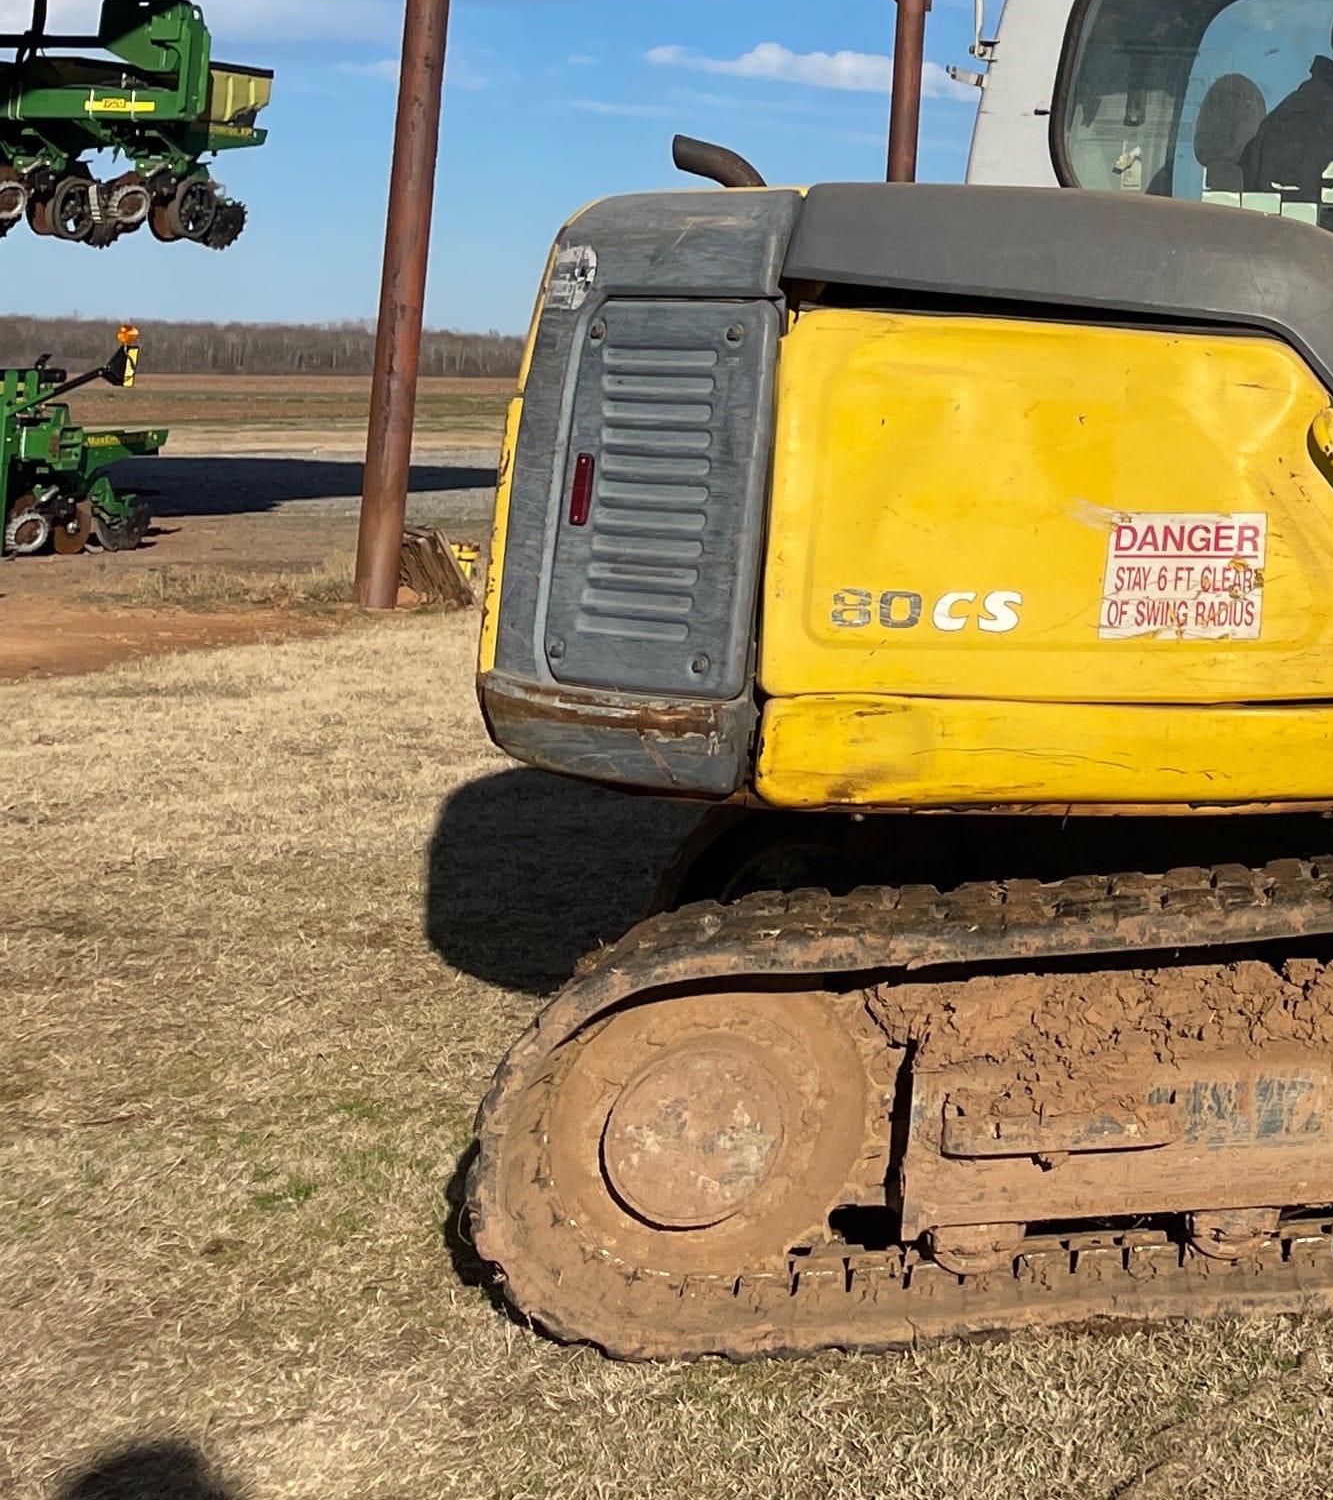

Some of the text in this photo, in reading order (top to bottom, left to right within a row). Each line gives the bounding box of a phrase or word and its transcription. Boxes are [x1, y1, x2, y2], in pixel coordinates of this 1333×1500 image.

[1114, 525, 1260, 552] DANGER
[1114, 566, 1253, 593] STAY 6 FT CLEAR
[1107, 600, 1255, 628] OF SWING RADIUS
